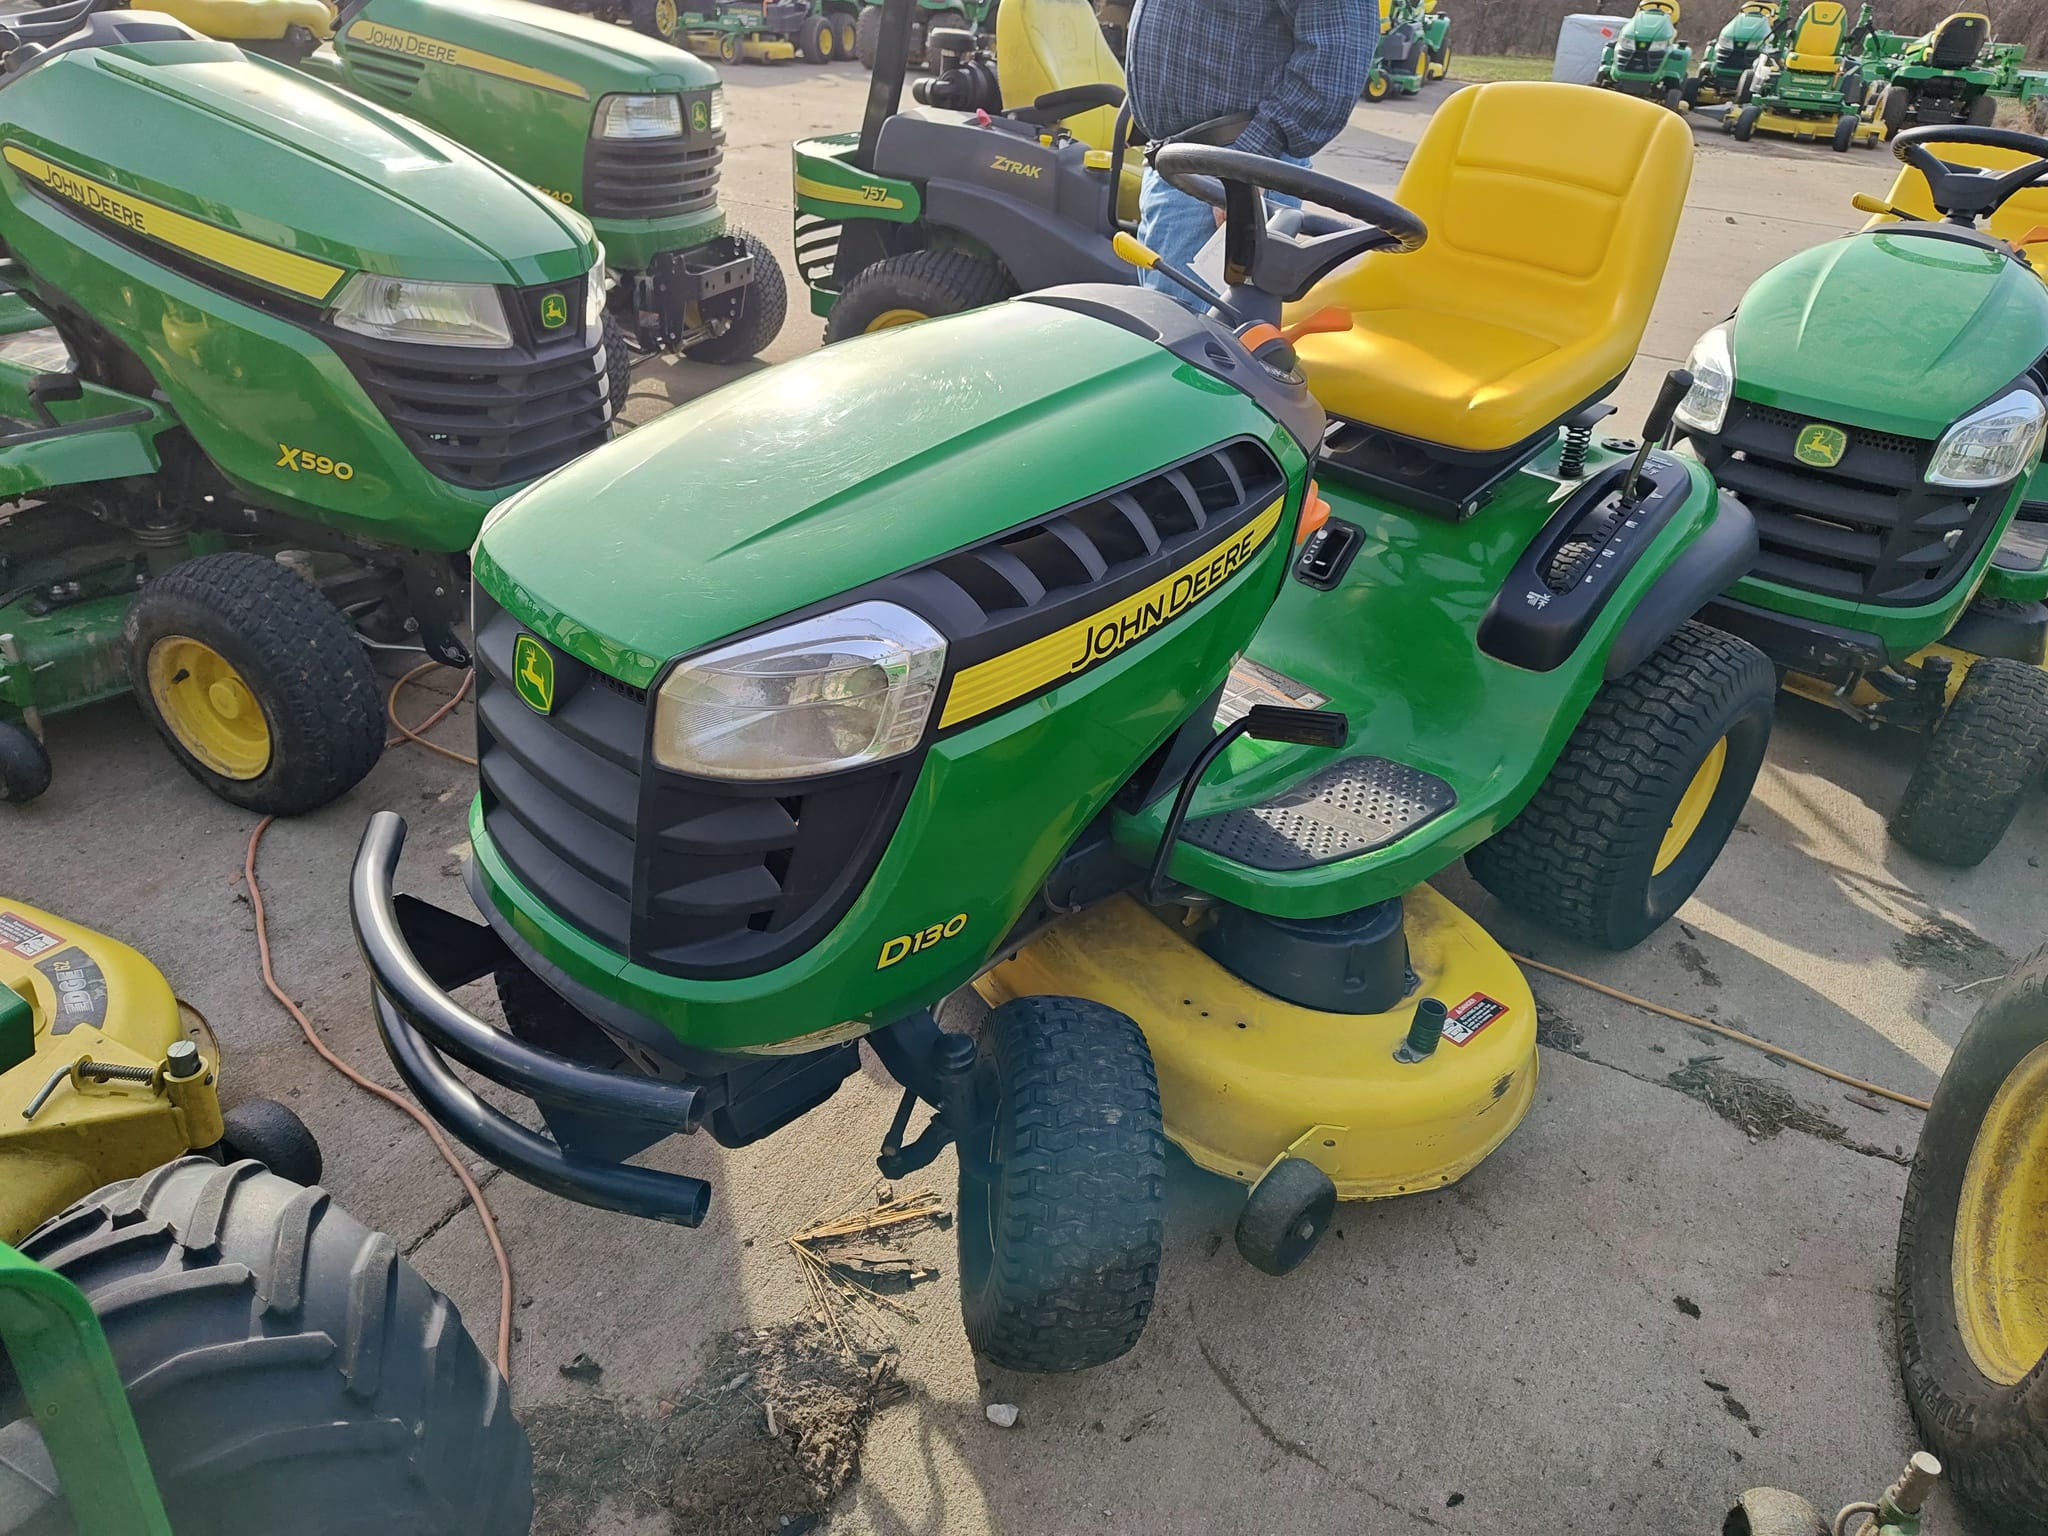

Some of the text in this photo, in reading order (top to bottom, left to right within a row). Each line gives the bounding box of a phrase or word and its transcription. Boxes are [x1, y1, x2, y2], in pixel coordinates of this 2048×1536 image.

[365, 27, 457, 62] JOHN DEERE
[43, 164, 146, 231] JOHN DEERE
[861, 185, 887, 202] 757
[275, 443, 354, 481] X590
[1071, 529, 1255, 669] JOHN DEERE
[876, 911, 969, 971] D130
